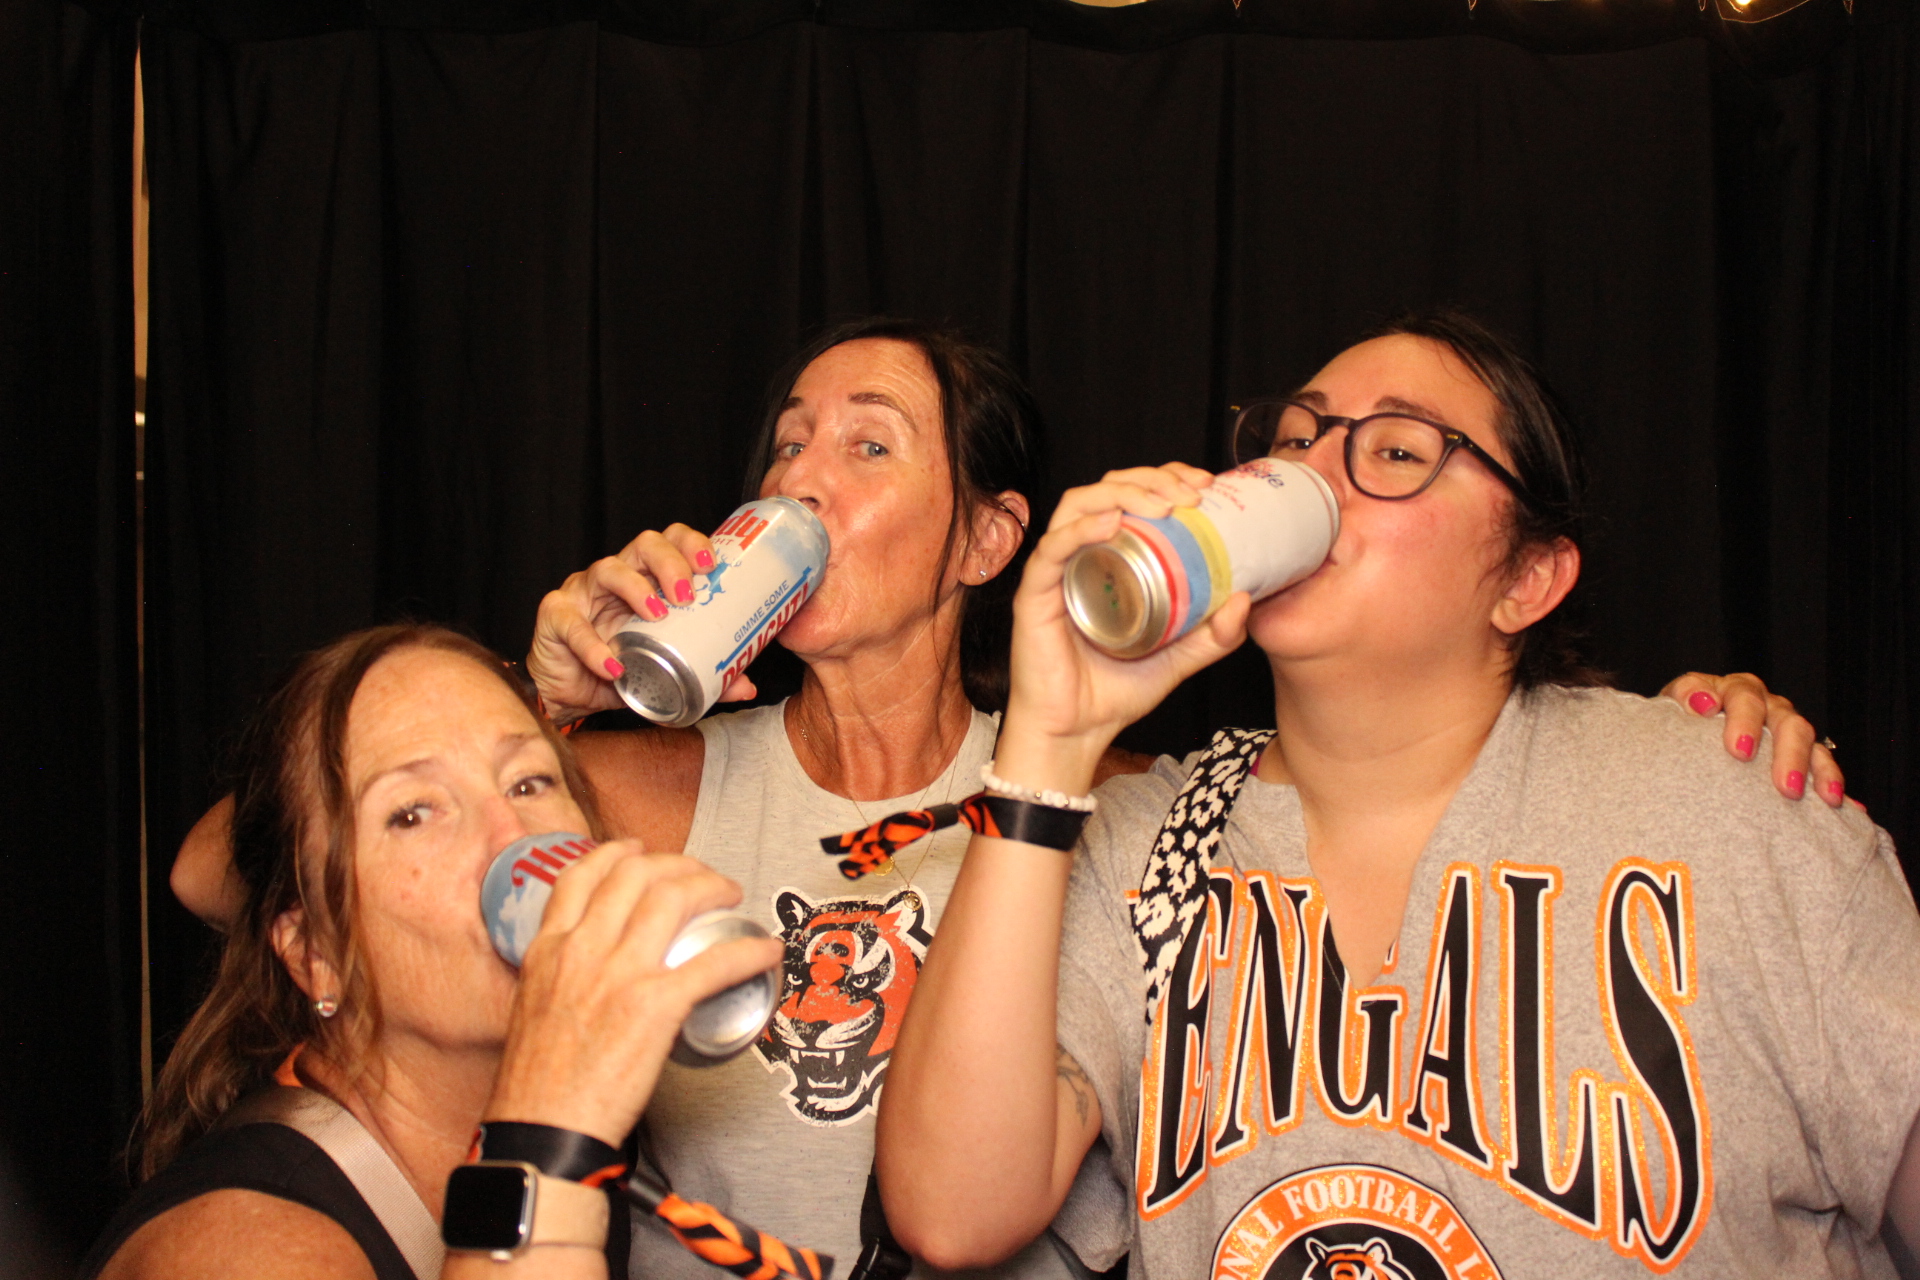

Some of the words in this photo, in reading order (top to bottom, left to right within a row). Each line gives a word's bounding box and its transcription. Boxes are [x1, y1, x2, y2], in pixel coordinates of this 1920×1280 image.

[709, 508, 770, 551] dy
[734, 607, 765, 642] GIMME
[764, 580, 789, 610] SOME
[1283, 1174, 1458, 1253] FOOTBALL
